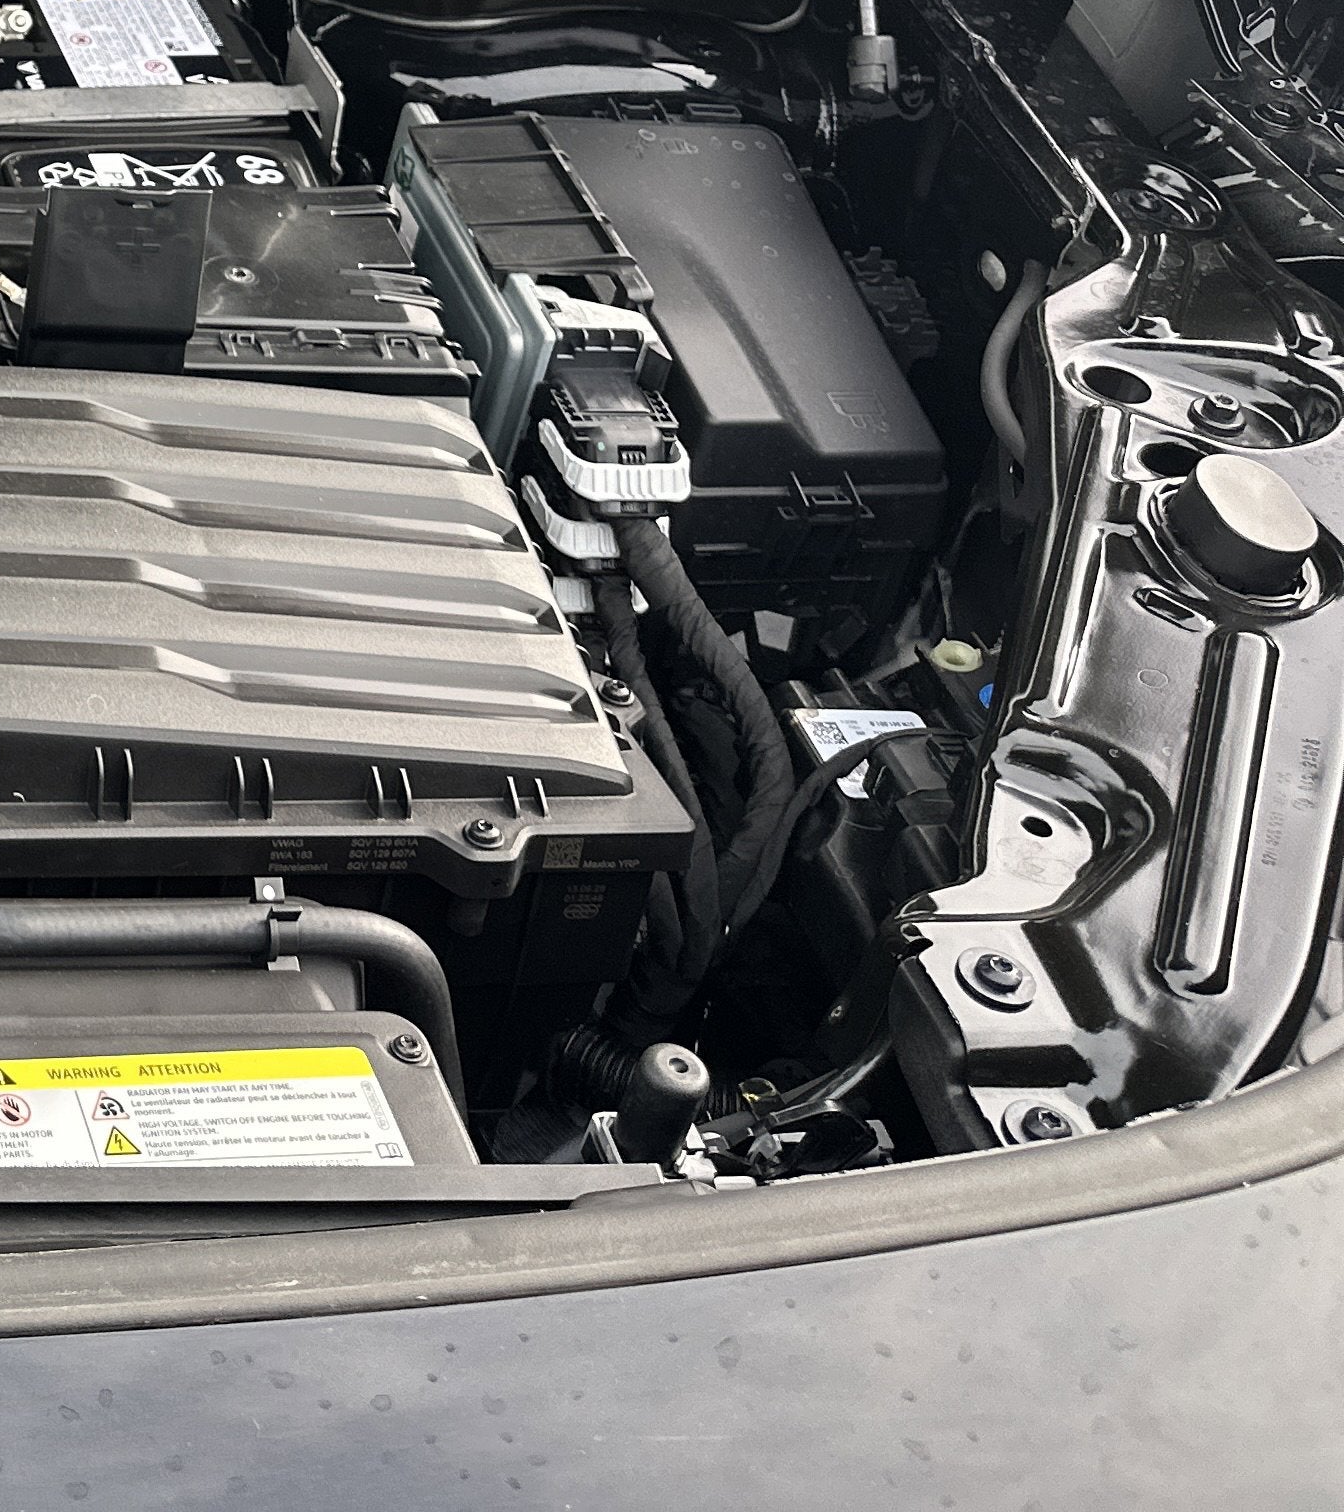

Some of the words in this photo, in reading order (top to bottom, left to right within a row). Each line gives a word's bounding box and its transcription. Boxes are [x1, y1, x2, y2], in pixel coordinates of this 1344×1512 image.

[46, 1066, 122, 1080] WARNING
[138, 1062, 222, 1077] ATTENTION
[126, 1088, 171, 1097] RADIATOR
[251, 1084, 268, 1092] ANY
[131, 1100, 142, 1108] Le
[144, 1098, 190, 1107] ventilateur
[192, 1096, 204, 1105] de
[206, 1095, 246, 1104] radiateur
[138, 1120, 161, 1128] HIGH
[204, 1118, 238, 1126] SWITCH
[258, 1115, 290, 1123] ENGINE
[292, 1114, 326, 1122] BEFORE
[326, 1112, 371, 1120] TOUCHING
[20, 1130, 53, 1138] MOTOR
[142, 1130, 181, 1138] IGNITION
[145, 1140, 172, 1148] Haute
[254, 1136, 286, 1144] moteur
[289, 1134, 313, 1142] avant
[328, 1132, 362, 1140] toucher
